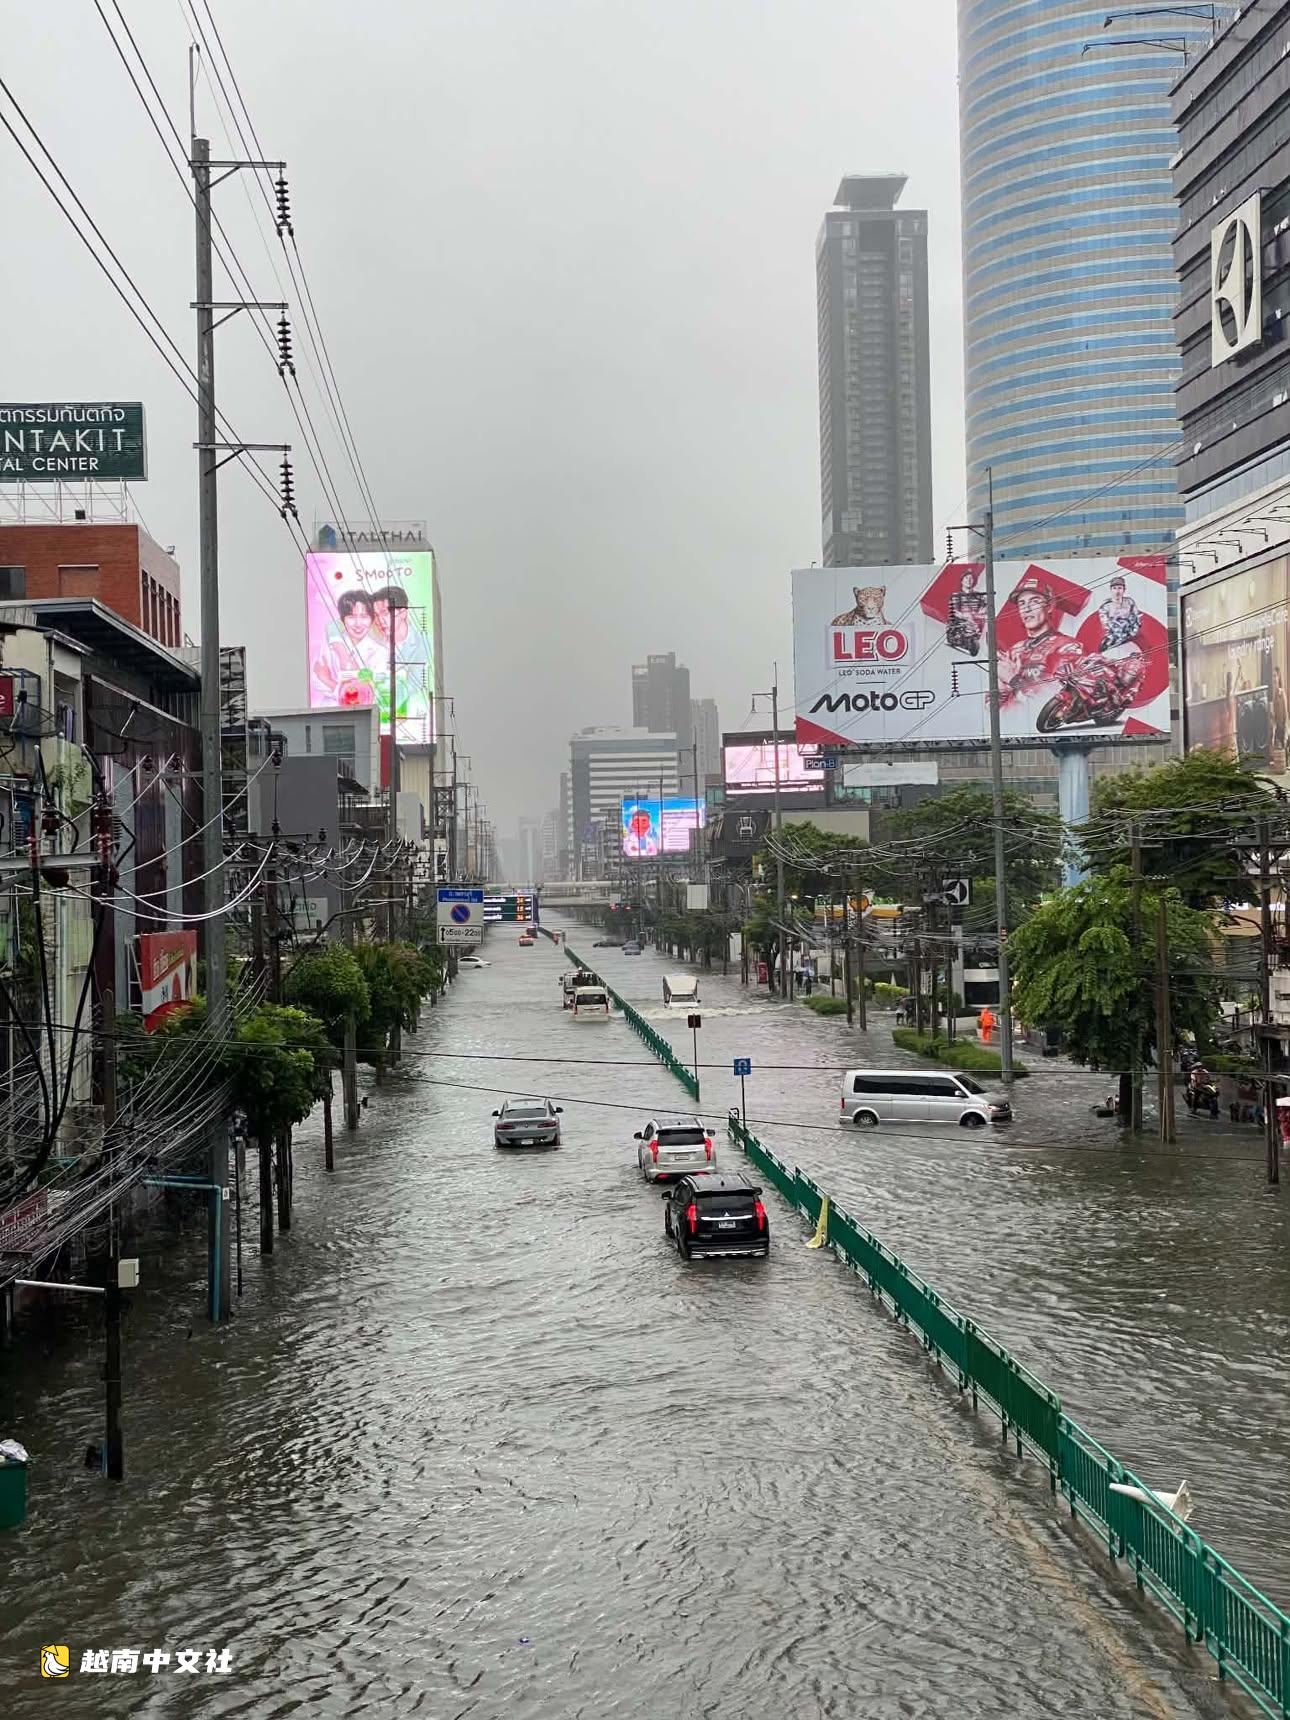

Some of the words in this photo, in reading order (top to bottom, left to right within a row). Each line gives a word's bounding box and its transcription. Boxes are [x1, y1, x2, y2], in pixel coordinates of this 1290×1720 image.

[5, 429, 125, 452] NTAKIT
[32, 458, 99, 471] CENTER
[833, 629, 909, 661] LEO
